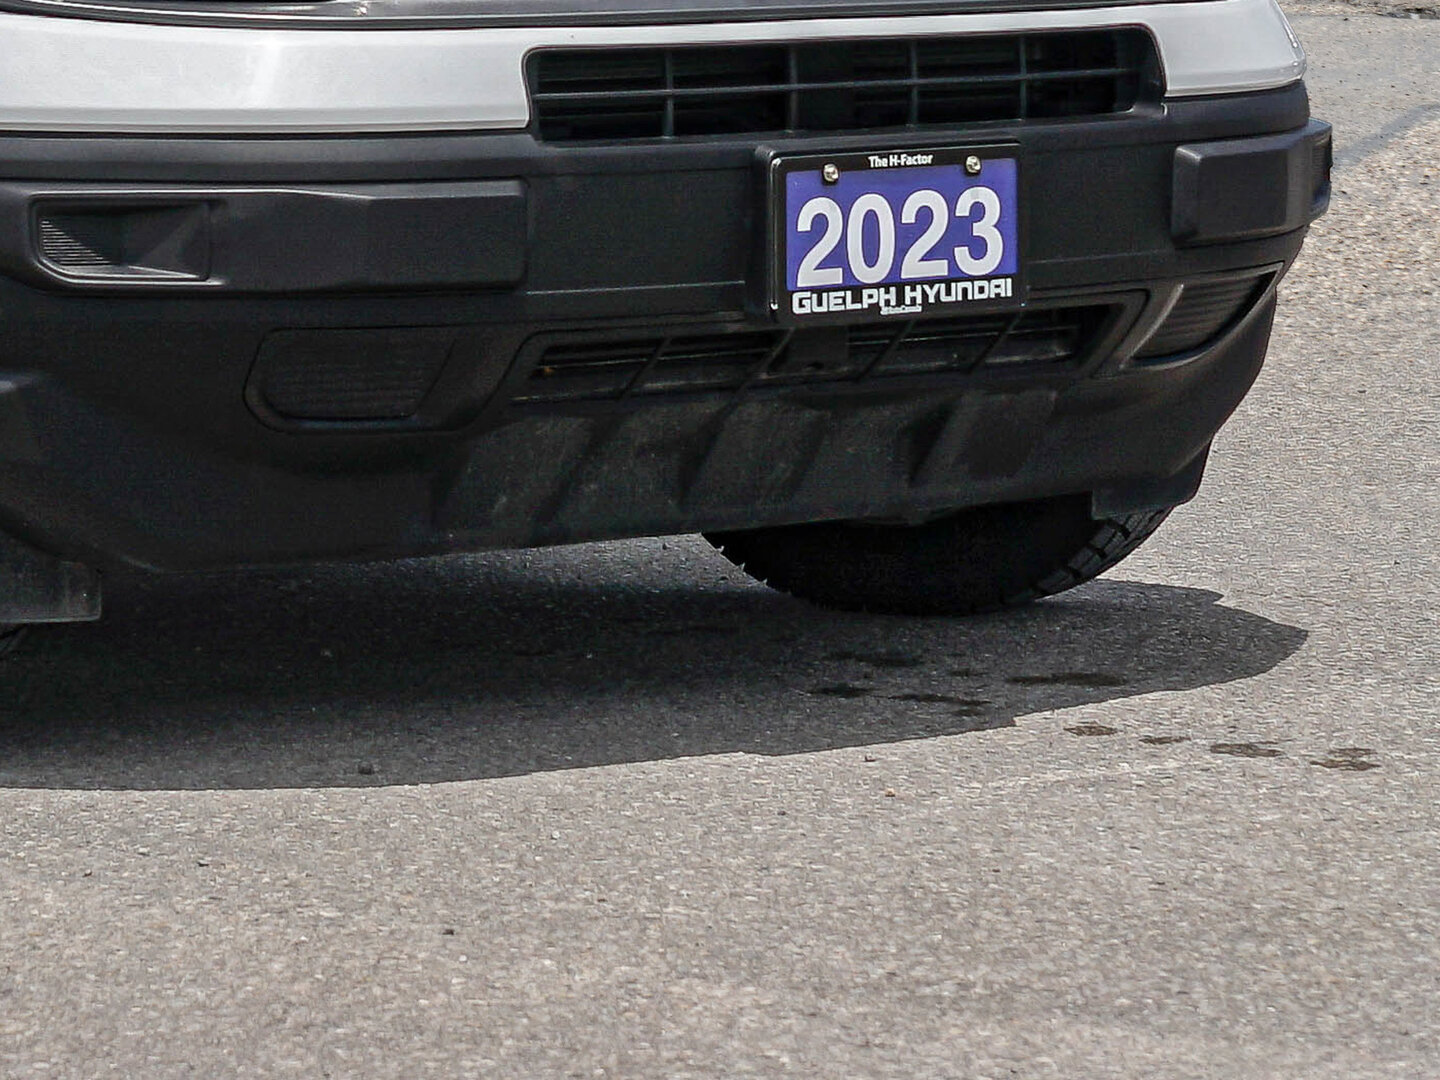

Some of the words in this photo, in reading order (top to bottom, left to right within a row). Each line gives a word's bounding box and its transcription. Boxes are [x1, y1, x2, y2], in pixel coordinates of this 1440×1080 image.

[868, 155, 889, 168] The
[889, 153, 934, 167] H-Factor
[796, 186, 1004, 288] 2023
[792, 286, 897, 314] GUELPH
[904, 278, 1012, 306] HYUNDAI
